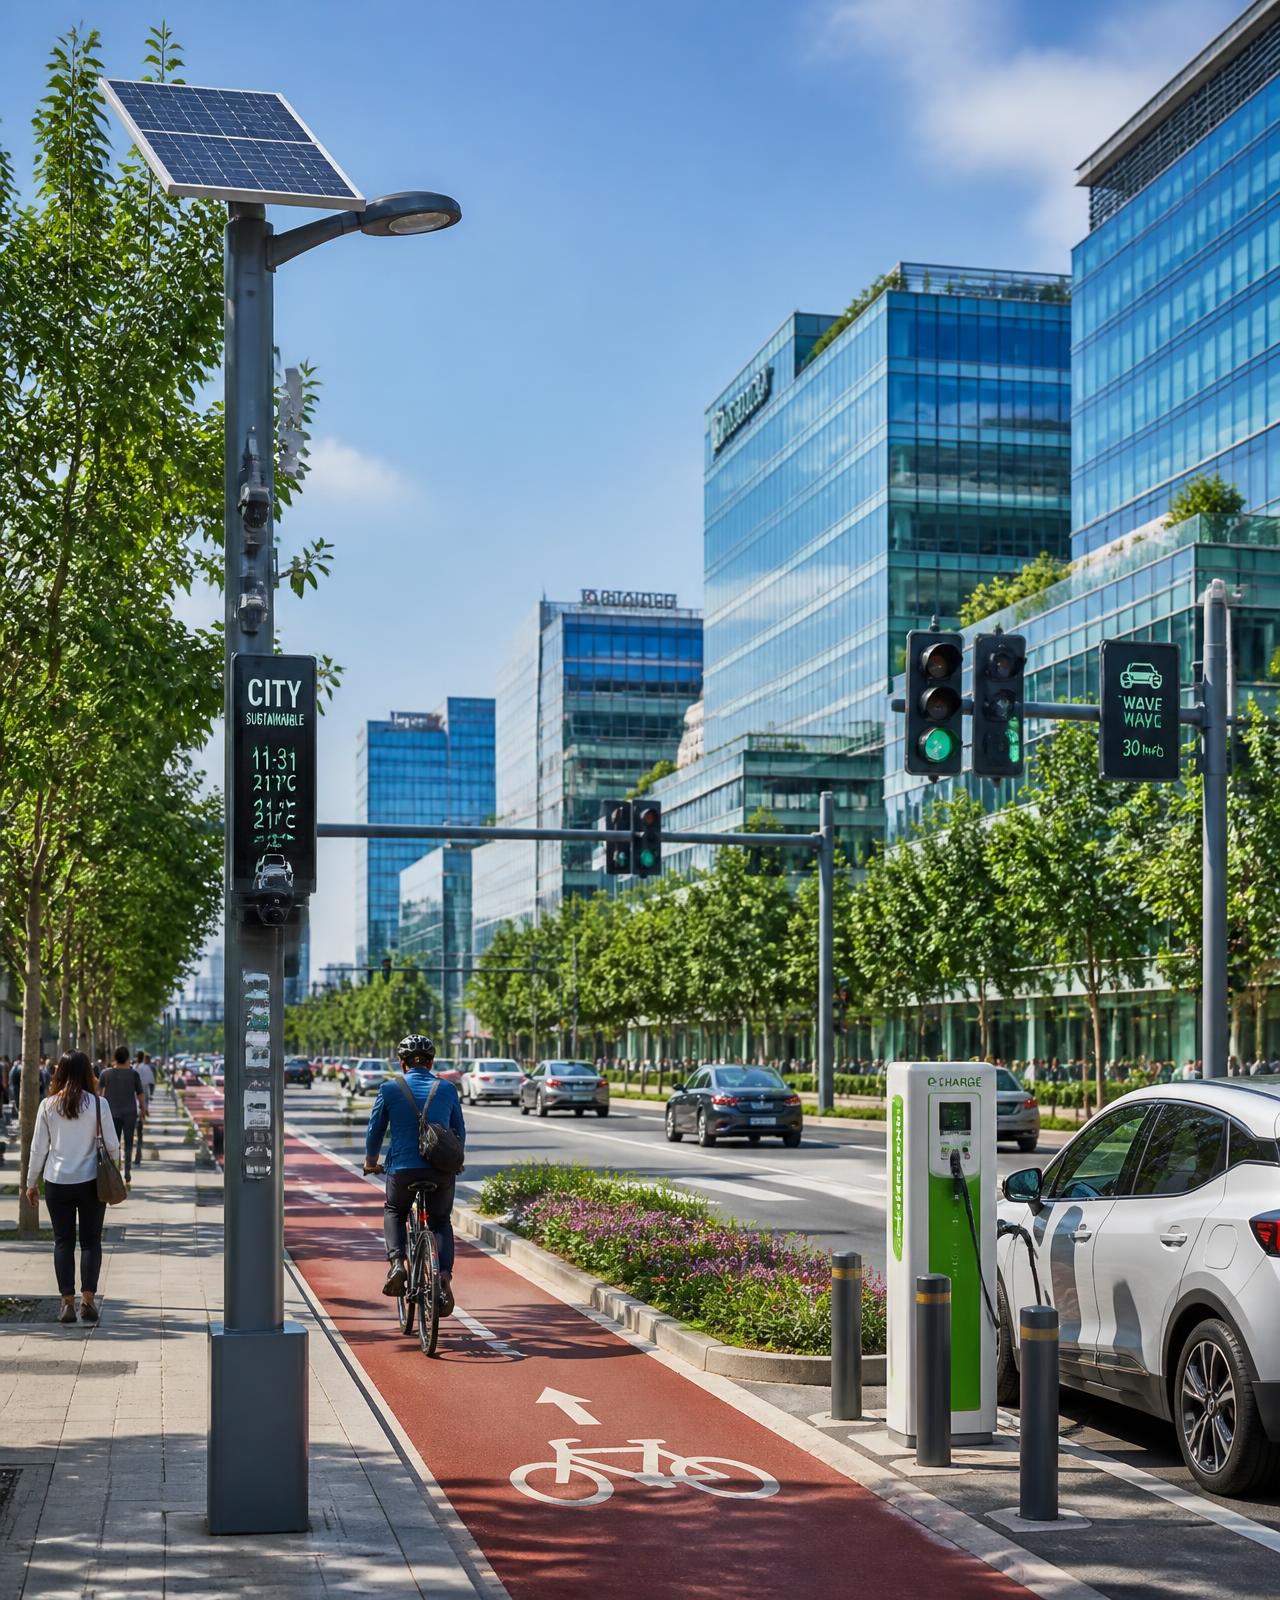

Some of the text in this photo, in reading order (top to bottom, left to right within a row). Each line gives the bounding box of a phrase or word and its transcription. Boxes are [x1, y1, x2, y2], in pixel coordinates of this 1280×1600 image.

[247, 678, 302, 709] CITY
[1123, 695, 1163, 712] WAVE
[1122, 738, 1141, 757] 30
